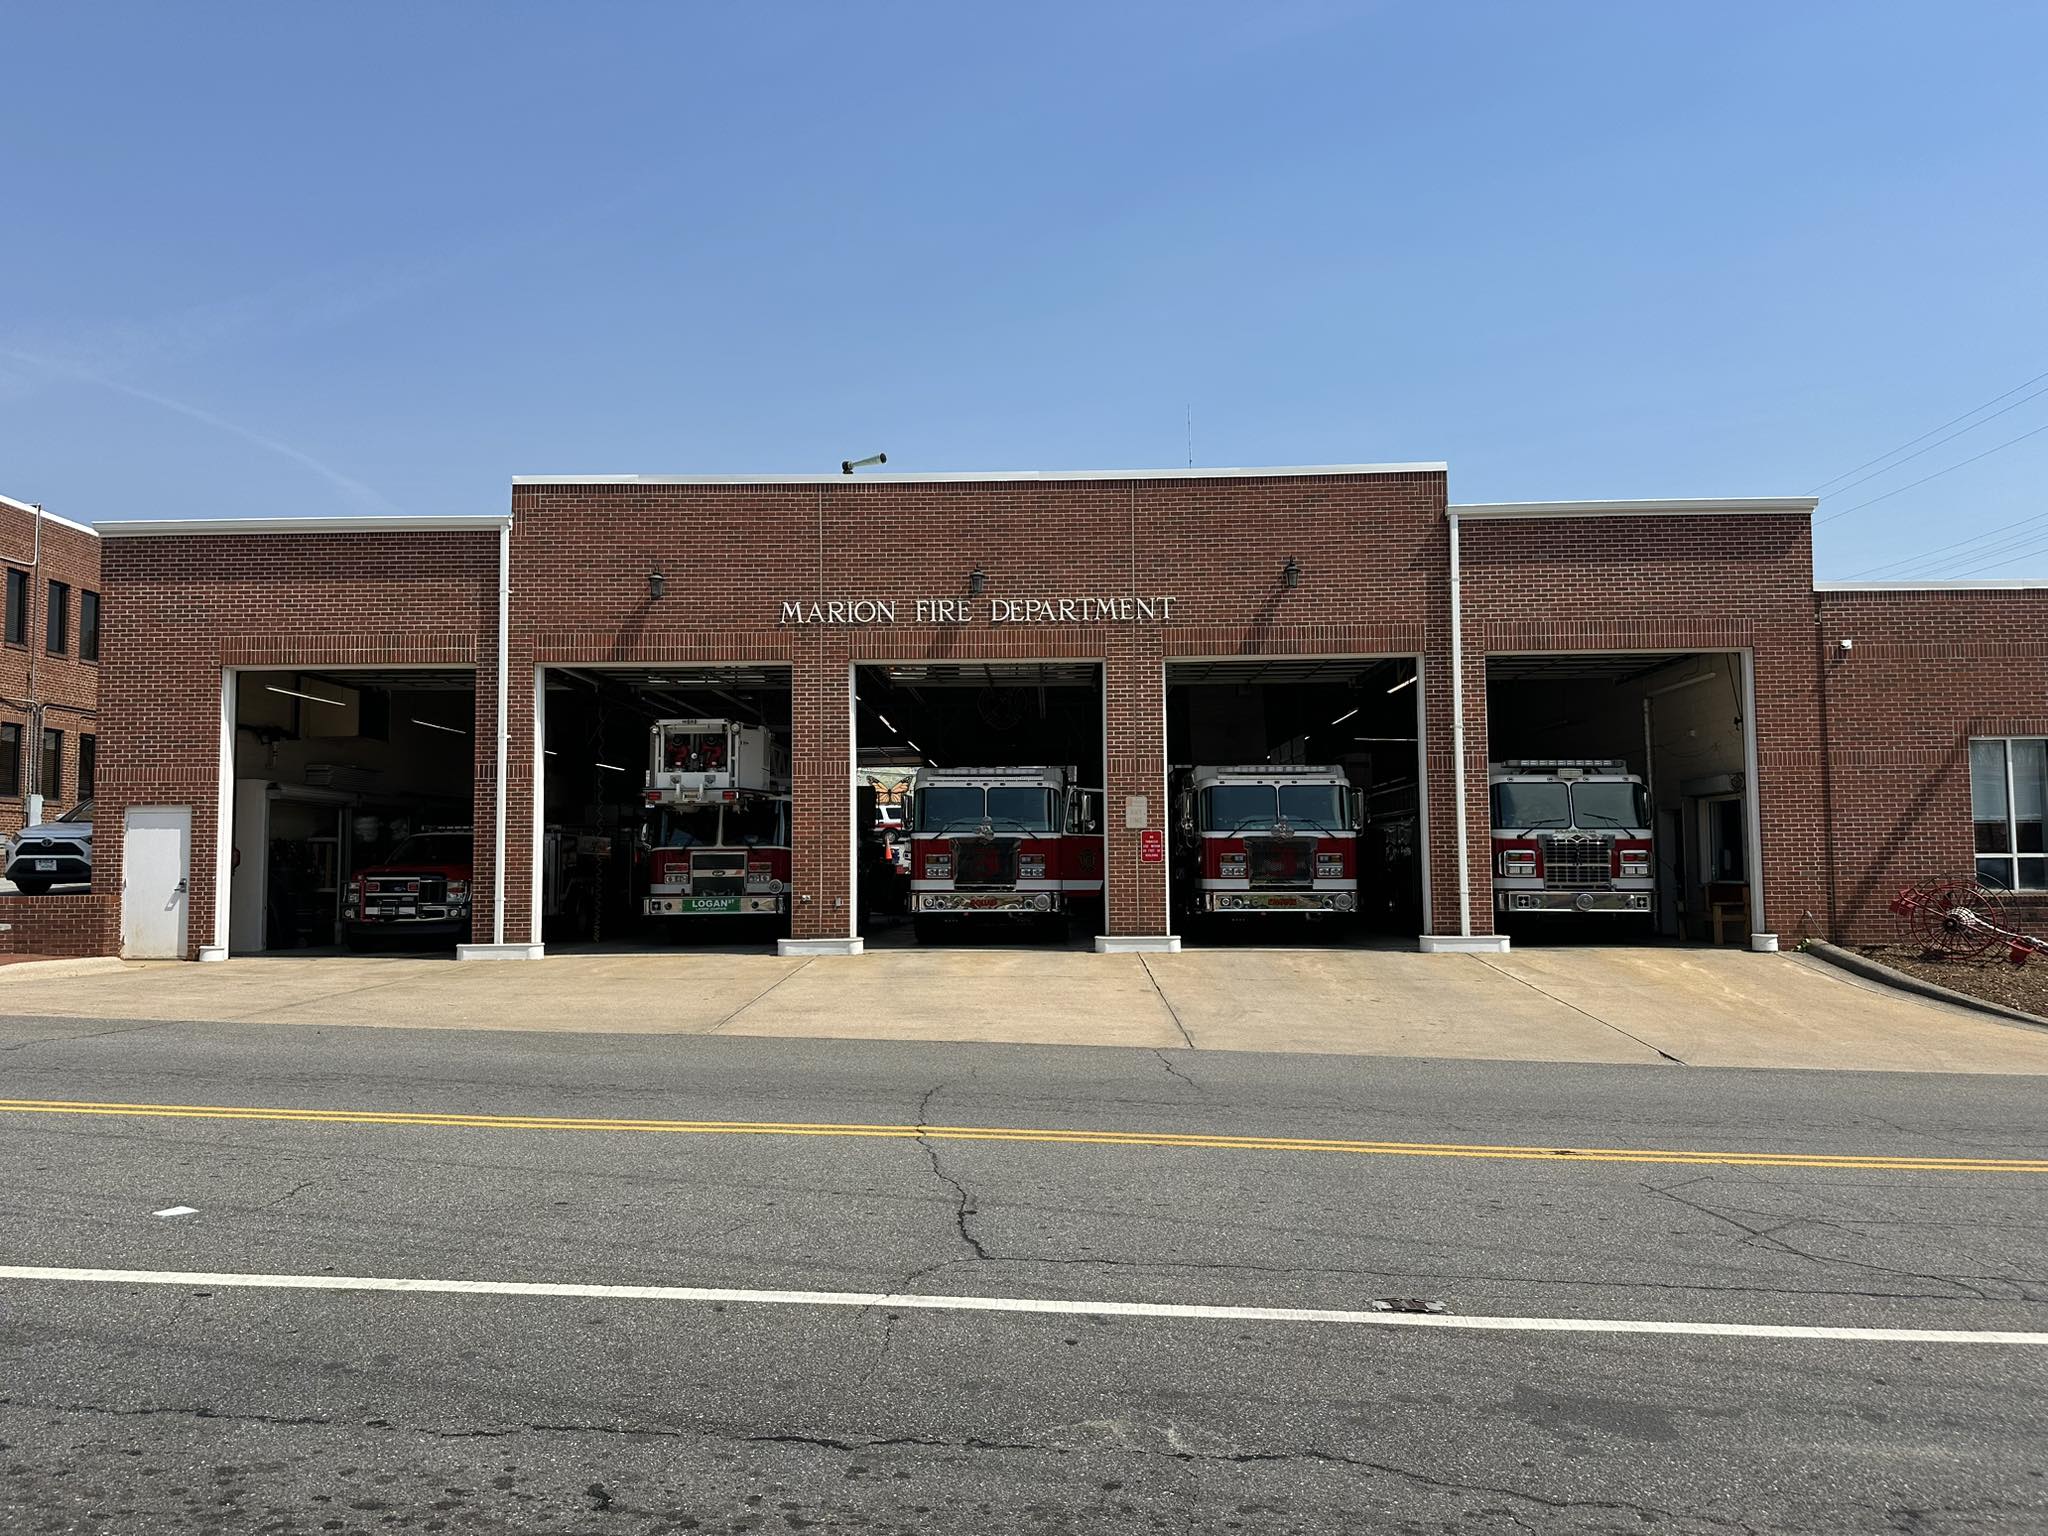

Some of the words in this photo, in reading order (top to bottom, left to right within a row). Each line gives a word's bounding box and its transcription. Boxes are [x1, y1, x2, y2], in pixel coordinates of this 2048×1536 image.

[780, 600, 896, 624] MARION
[916, 599, 972, 623] FIRE
[991, 596, 1177, 623] DEPARTMENT
[692, 899, 728, 908] LOGAN
